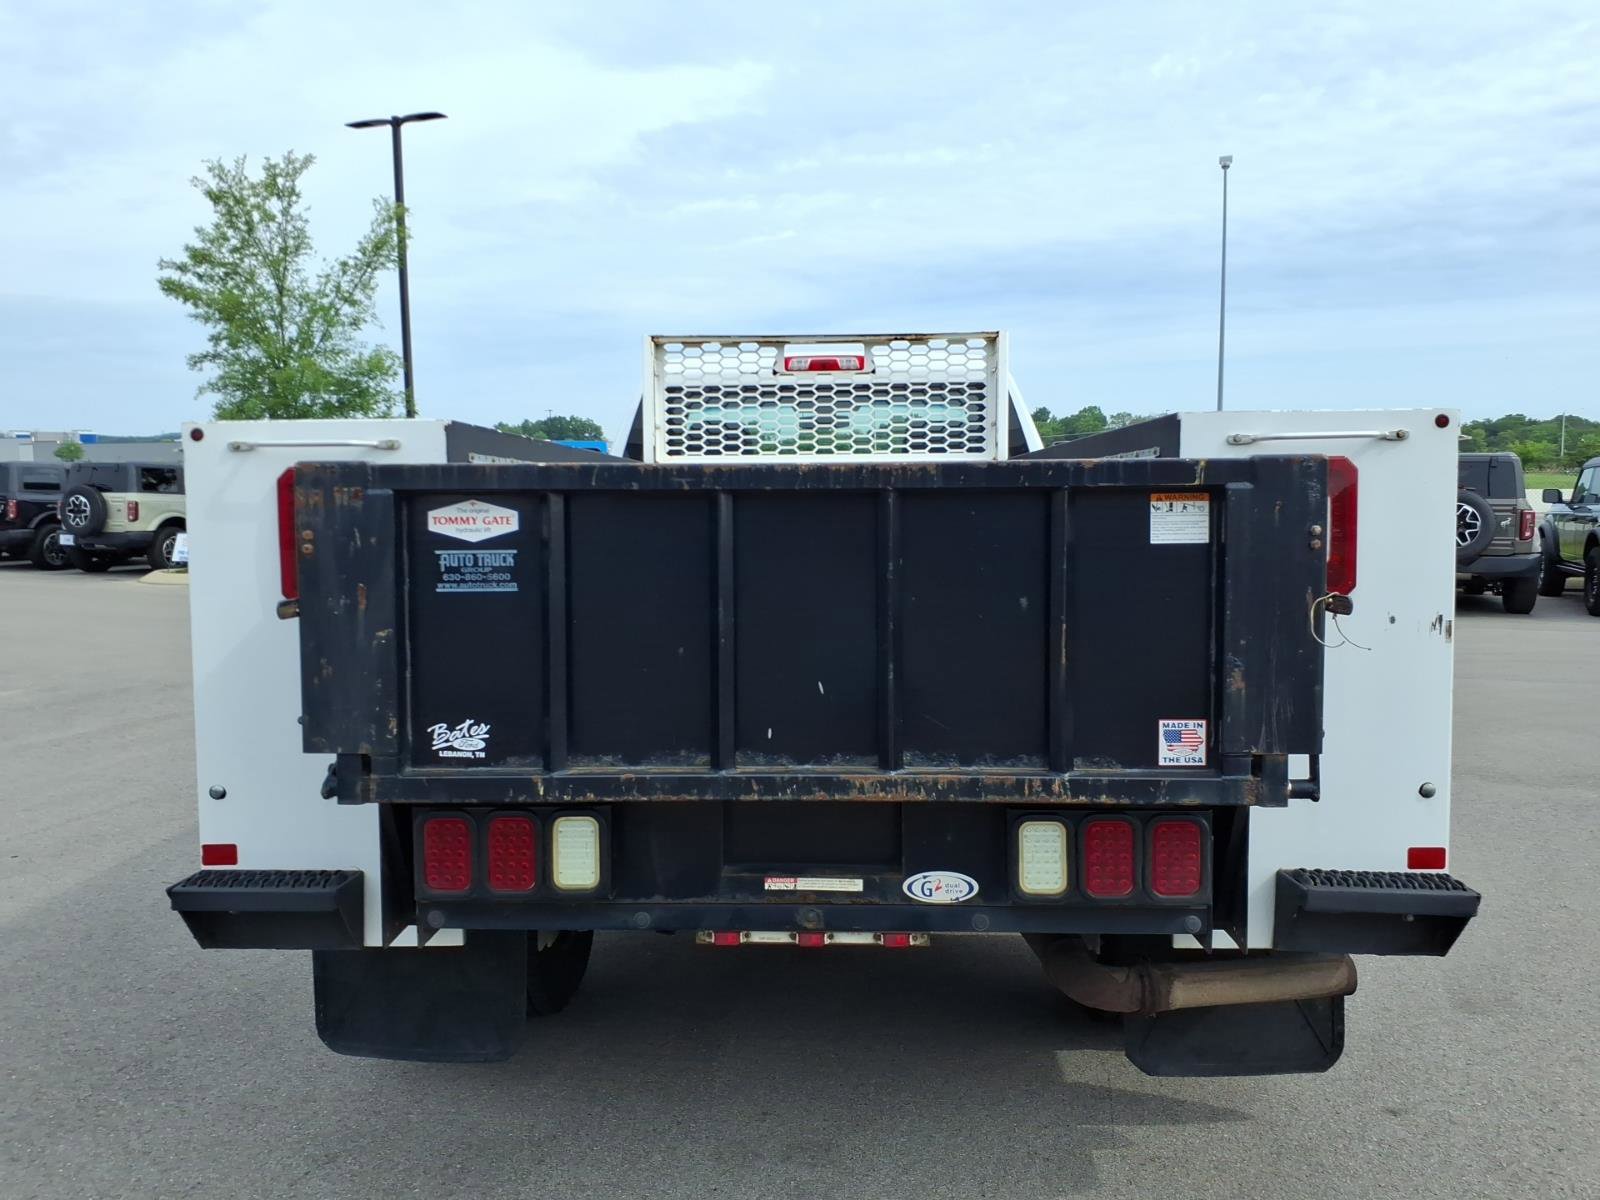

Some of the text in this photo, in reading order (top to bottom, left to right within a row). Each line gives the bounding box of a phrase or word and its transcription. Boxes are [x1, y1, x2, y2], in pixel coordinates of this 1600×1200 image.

[432, 516, 512, 525] TOMMY GATE
[438, 554, 514, 572] AUTO TRUCK
[427, 719, 491, 745] Bates
